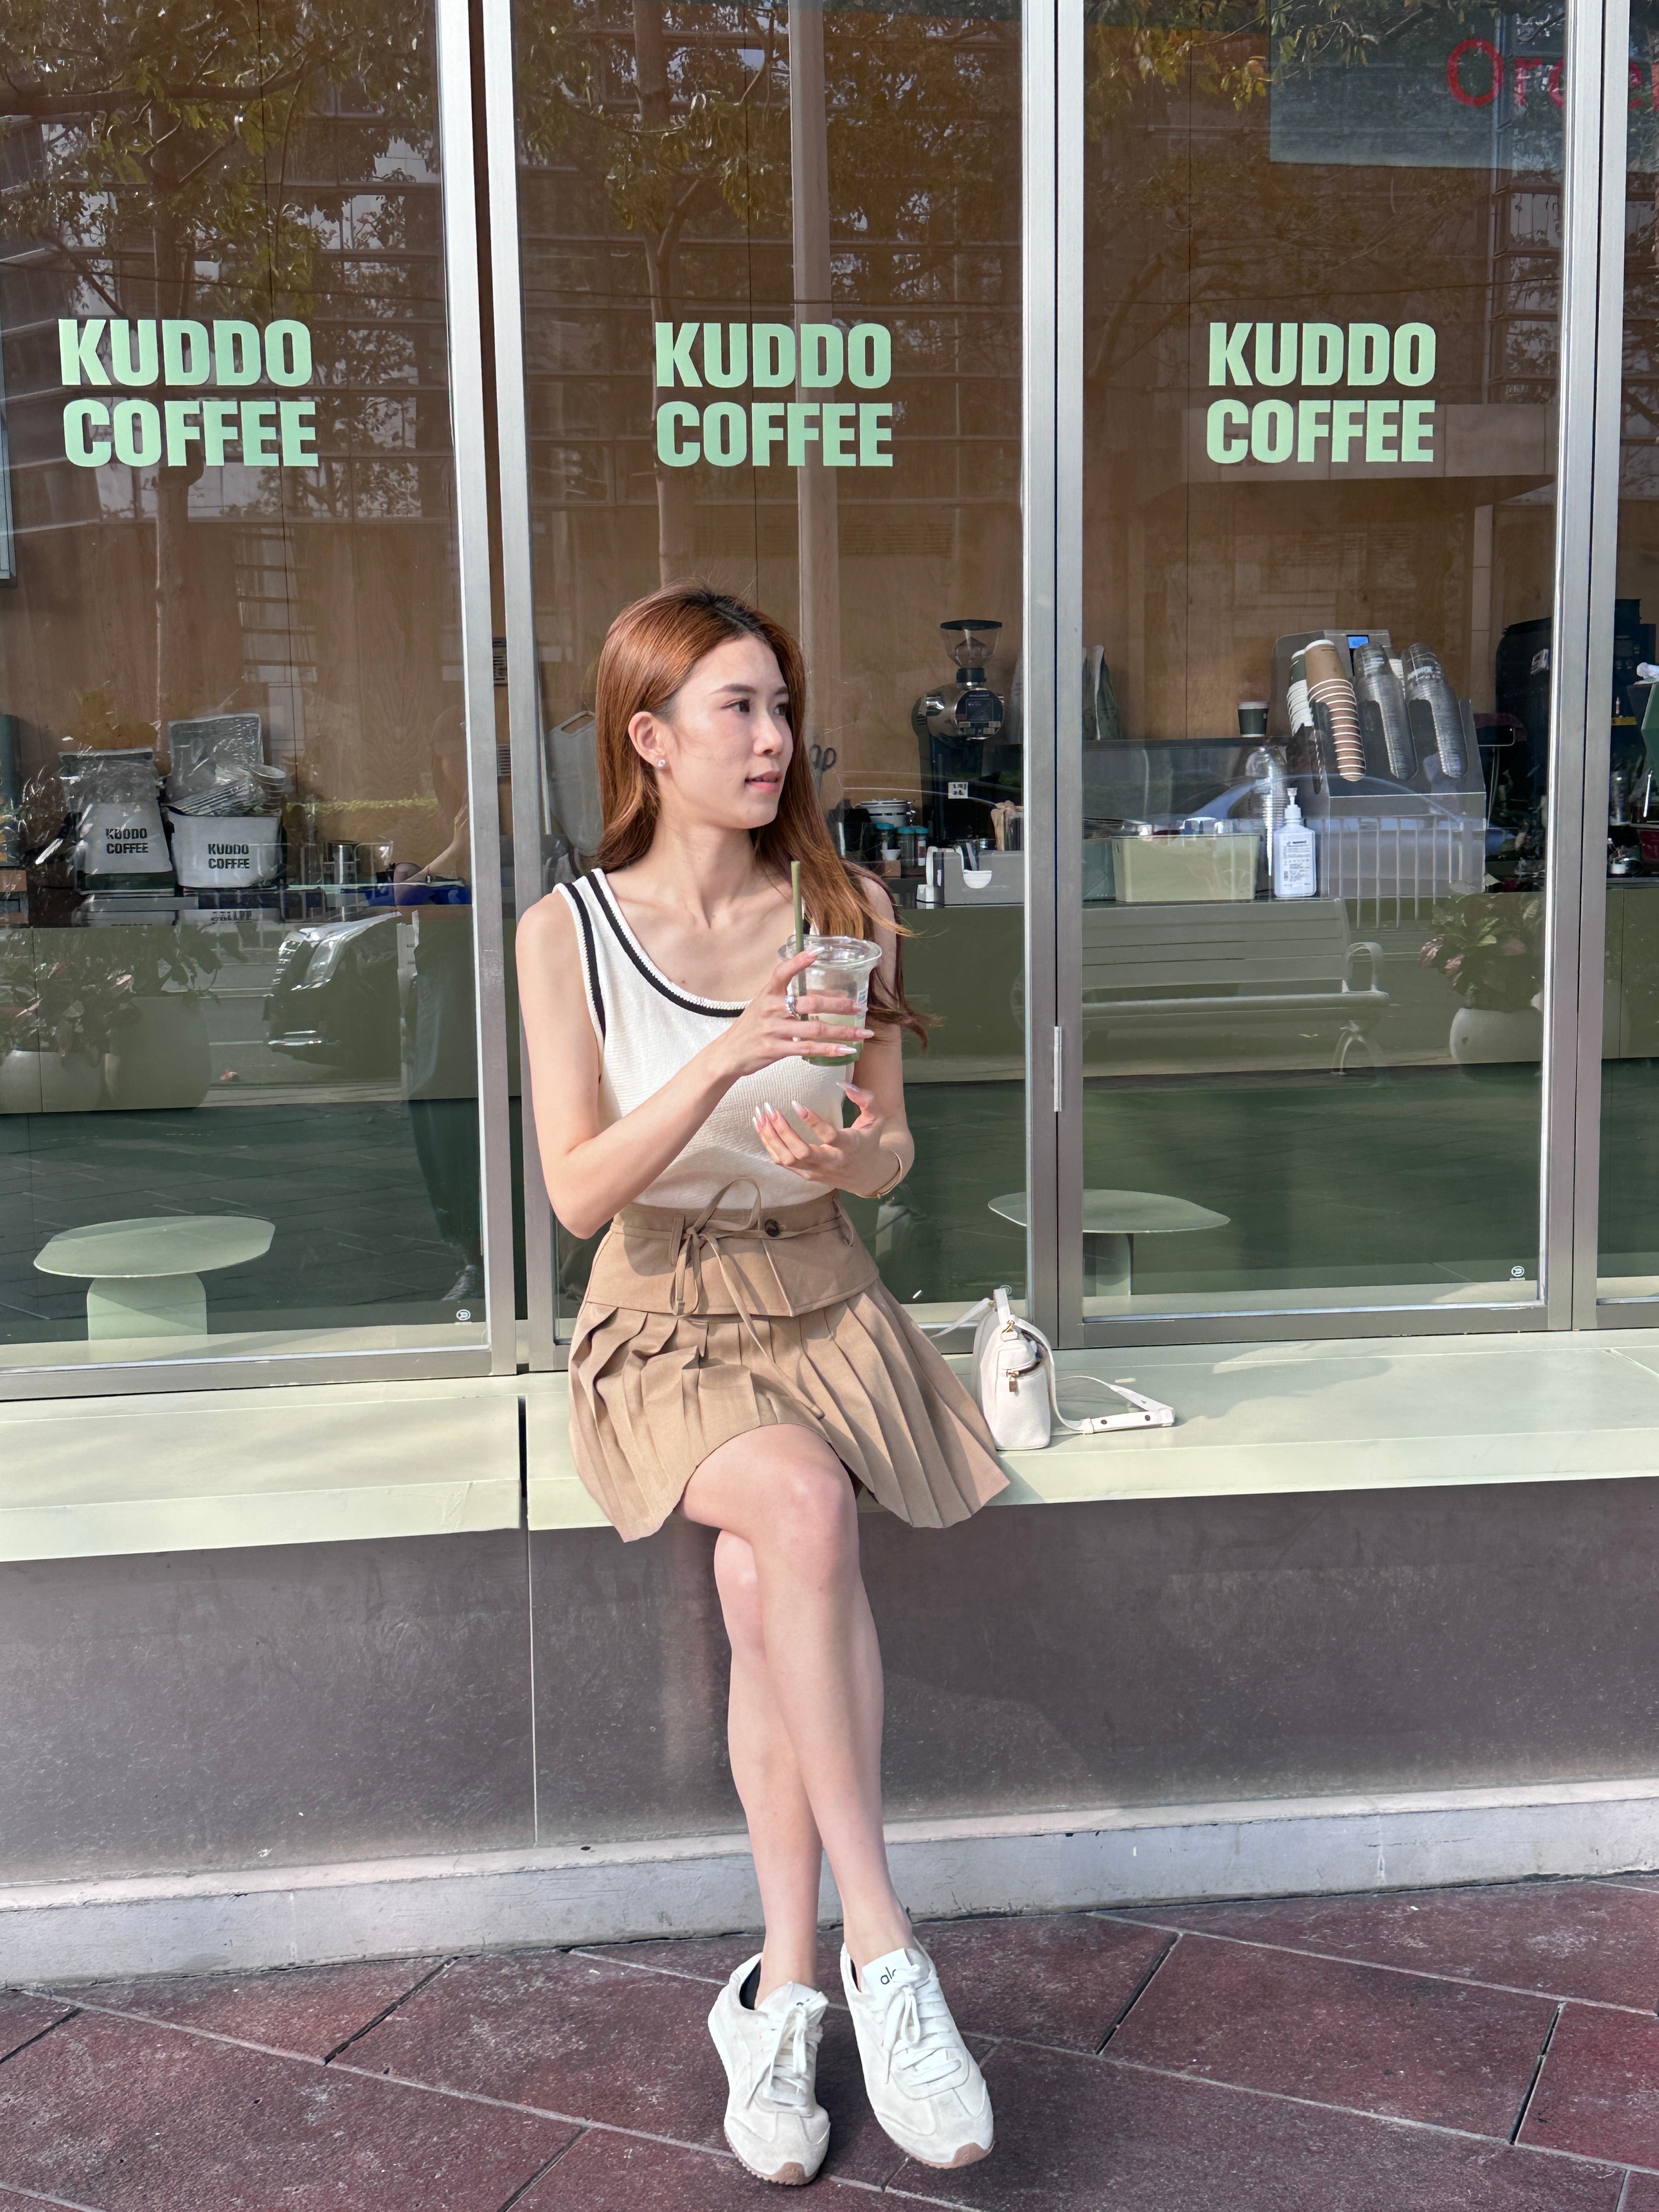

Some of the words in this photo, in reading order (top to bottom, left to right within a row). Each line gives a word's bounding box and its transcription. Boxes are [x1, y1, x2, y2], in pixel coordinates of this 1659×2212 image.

[58, 319, 312, 387] KUDDO
[656, 322, 891, 388] KUDDO
[1209, 322, 1436, 386] KUDDO
[63, 399, 318, 467] COFFEE
[657, 401, 893, 466] COFFEE
[1206, 399, 1435, 464] COFFEE
[106, 828, 148, 839] KUDDO
[106, 843, 149, 854] COFFEE
[208, 843, 249, 855] KUDDO
[208, 858, 250, 870] COFFEE
[880, 1966, 897, 1985] al
